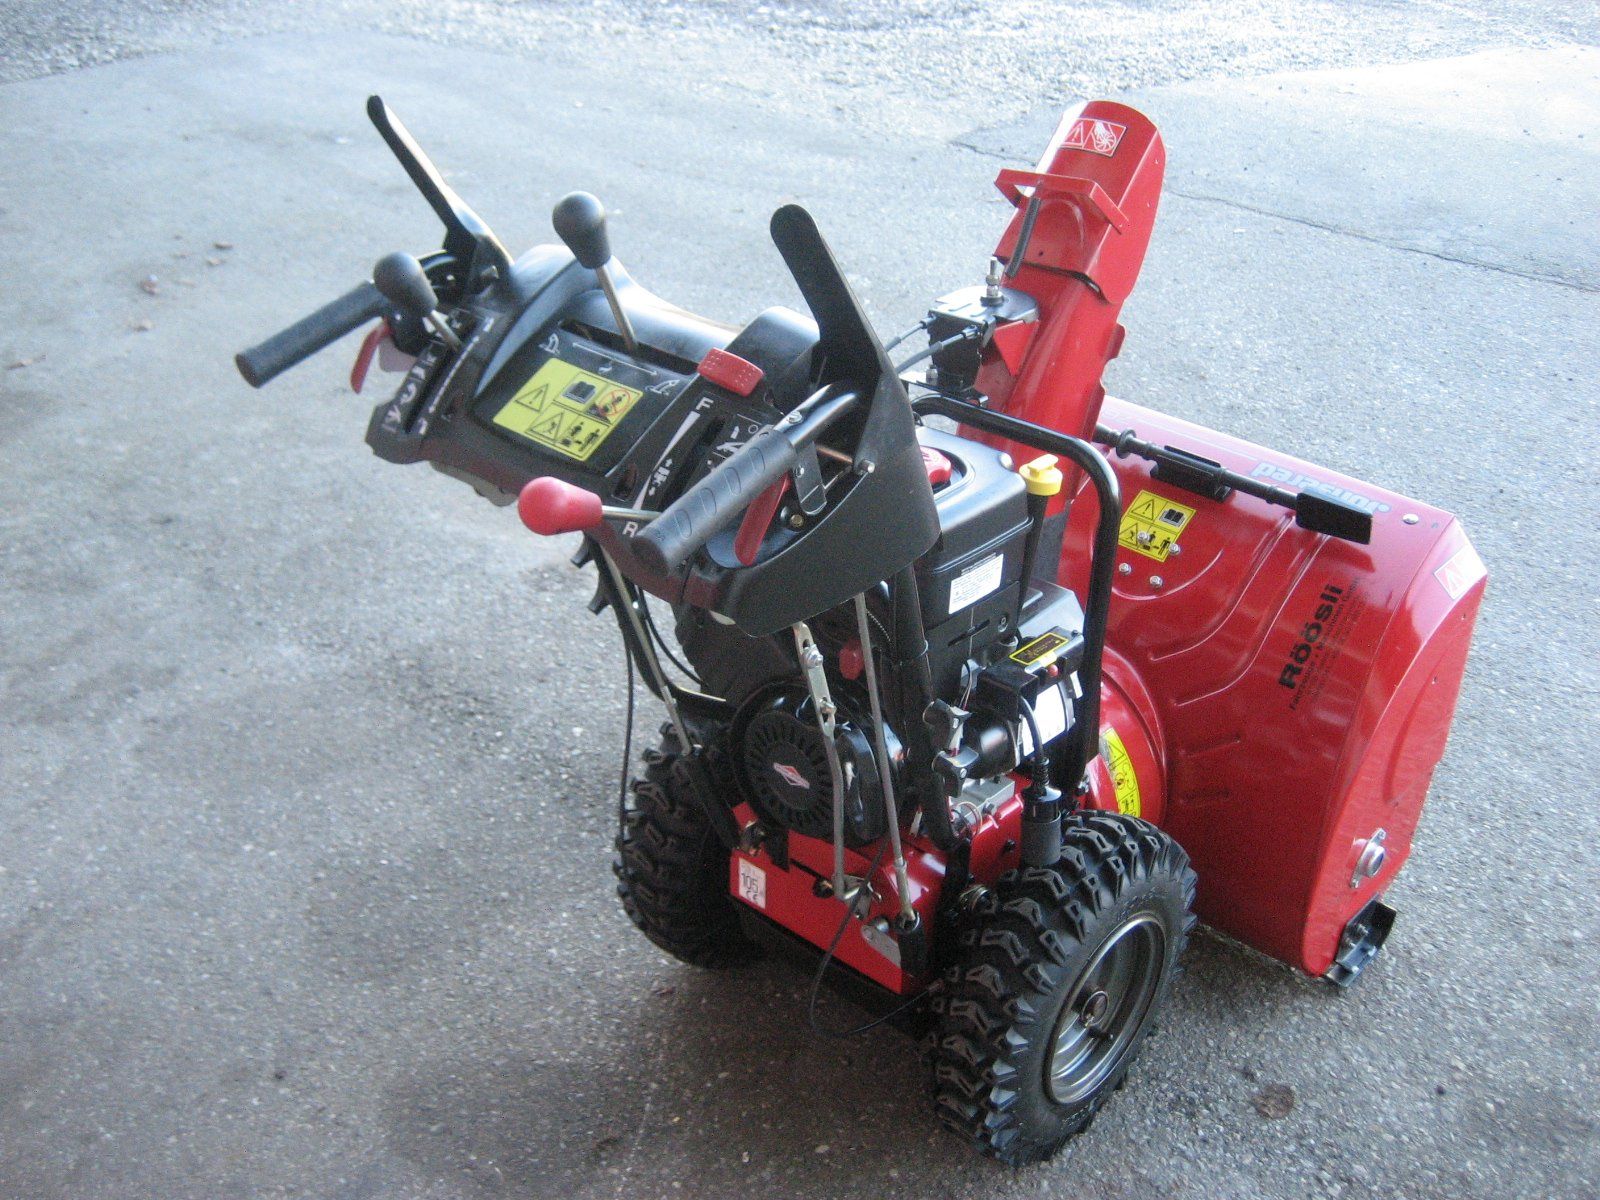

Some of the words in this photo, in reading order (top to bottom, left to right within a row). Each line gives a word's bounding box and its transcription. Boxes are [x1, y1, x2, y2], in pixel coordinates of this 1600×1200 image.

[695, 396, 714, 412] F
[622, 520, 638, 538] R
[1278, 584, 1343, 689] Röösli
